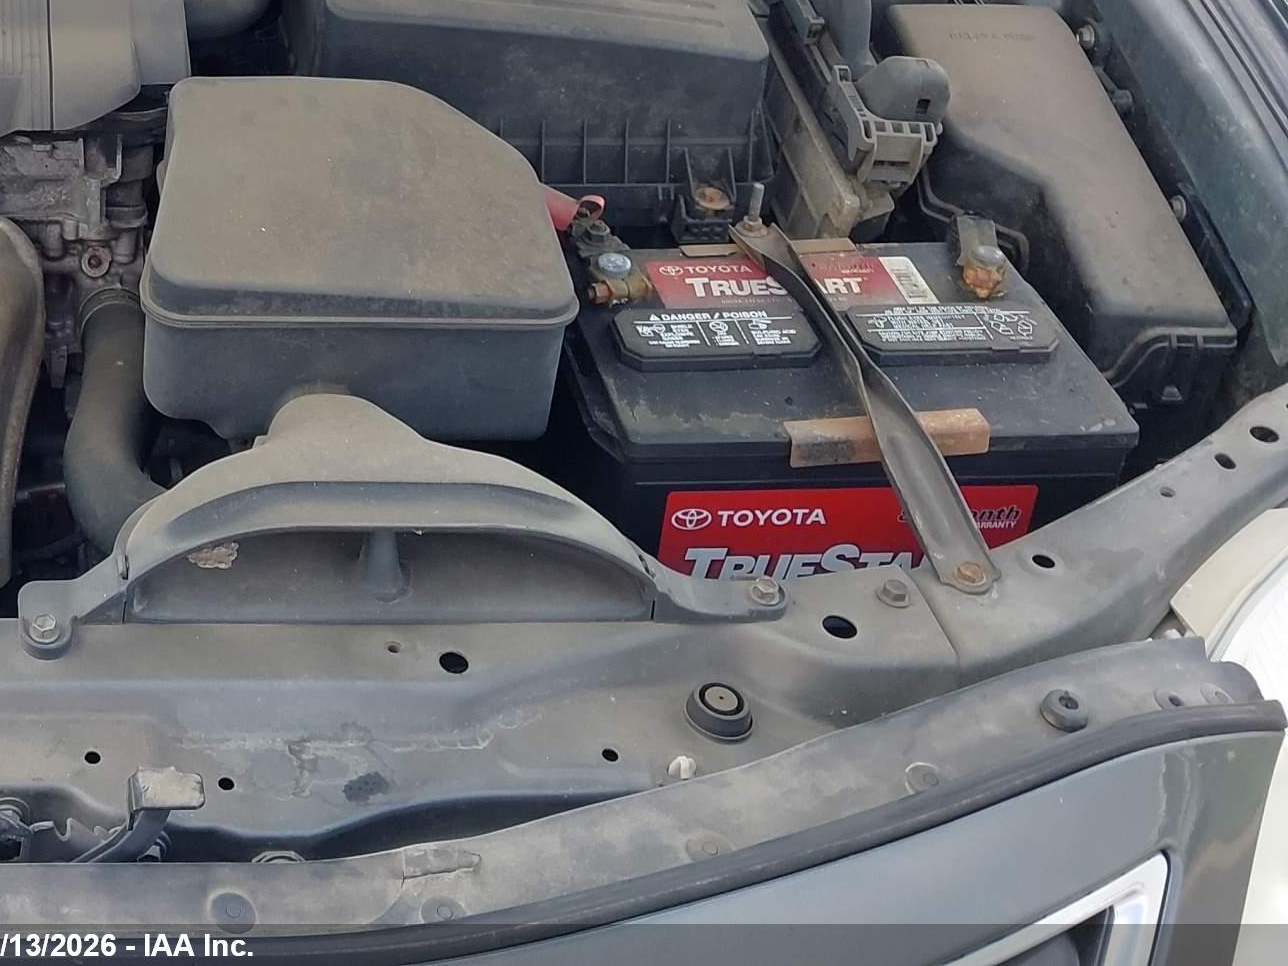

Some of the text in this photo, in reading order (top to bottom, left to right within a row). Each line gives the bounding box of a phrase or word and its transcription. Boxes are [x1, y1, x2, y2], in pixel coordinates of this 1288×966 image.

[685, 264, 753, 274] TOYOTA
[661, 313, 711, 321] DANGER
[722, 310, 767, 319] POISON
[717, 508, 826, 527] TOYOTA
